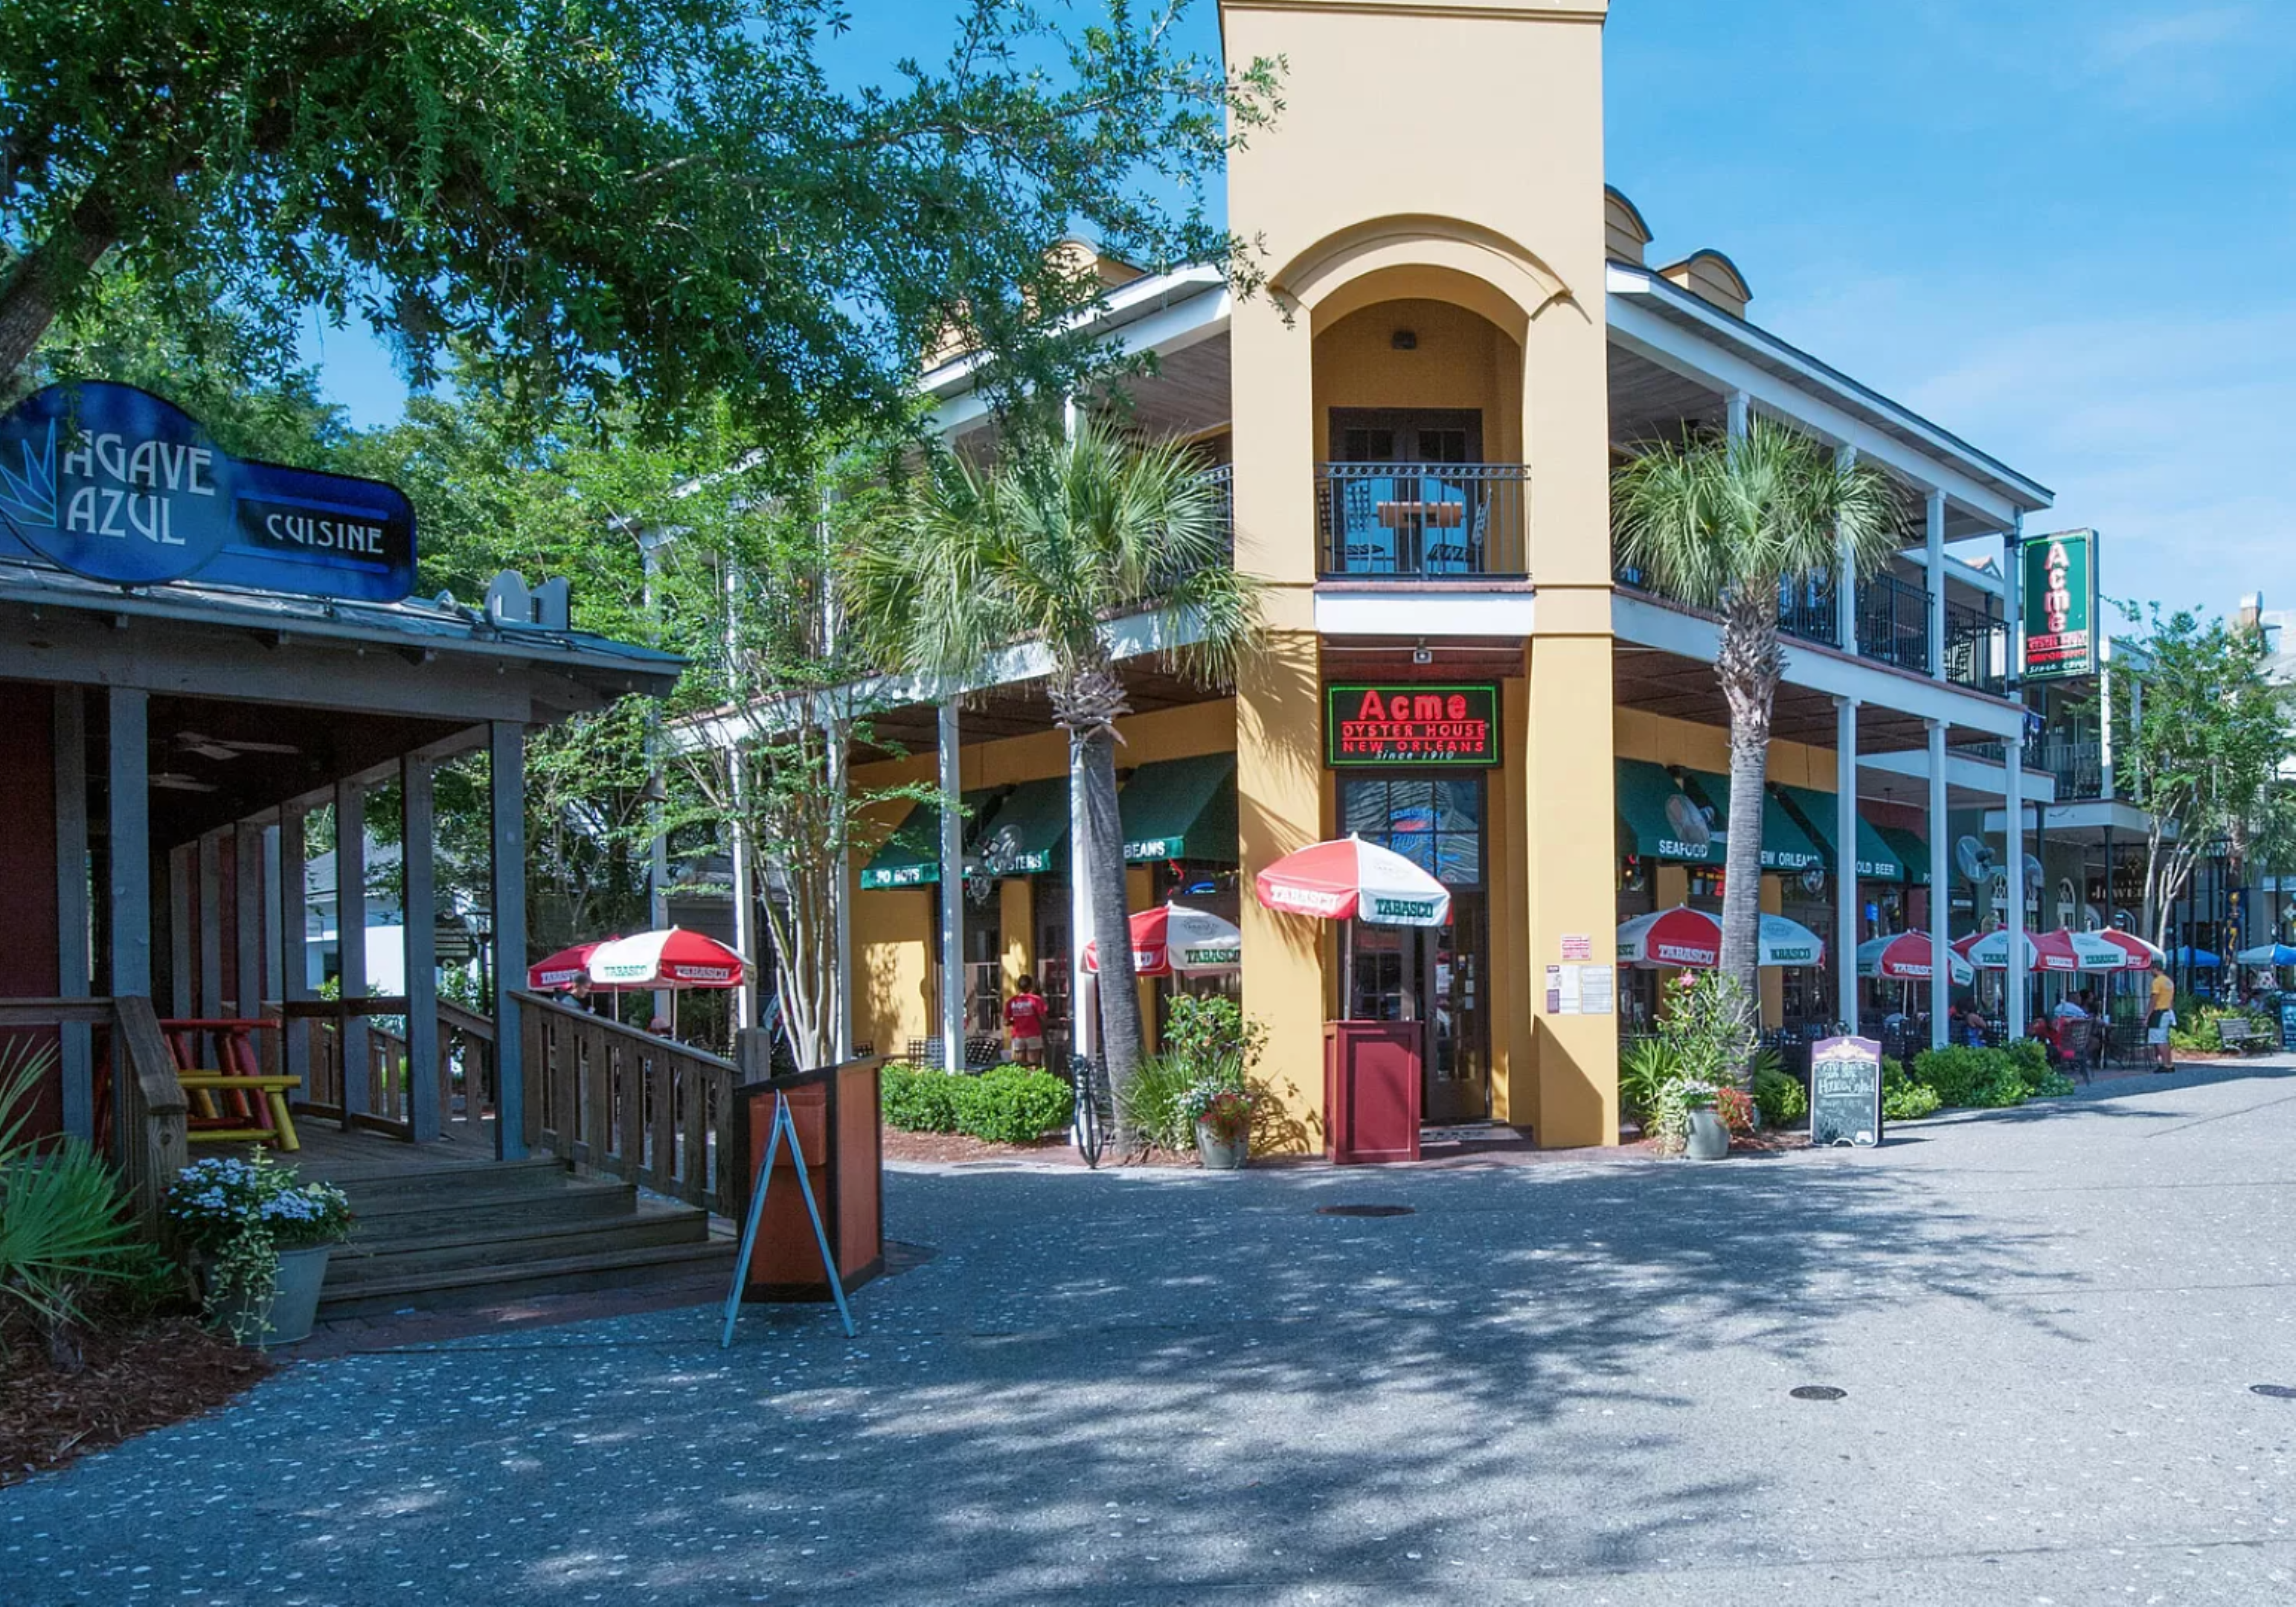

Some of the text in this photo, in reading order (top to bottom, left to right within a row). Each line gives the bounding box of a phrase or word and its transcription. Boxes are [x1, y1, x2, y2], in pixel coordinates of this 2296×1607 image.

[63, 429, 215, 496] AGAVE
[66, 486, 185, 545] AZUL
[266, 513, 385, 554] CUISINE
[1359, 690, 1467, 720] Acme
[1341, 724, 1485, 737] OYSTER HOUSE
[1341, 741, 1484, 752] NEW ORLEANS
[1123, 841, 1166, 859] BEANS
[1658, 839, 1708, 859] SEAFOOD
[1760, 850, 1775, 865] EW
[1855, 860, 1895, 876] OLD BEER
[1375, 898, 1434, 918] TABASCO
[1658, 944, 1716, 963] TABASCO
